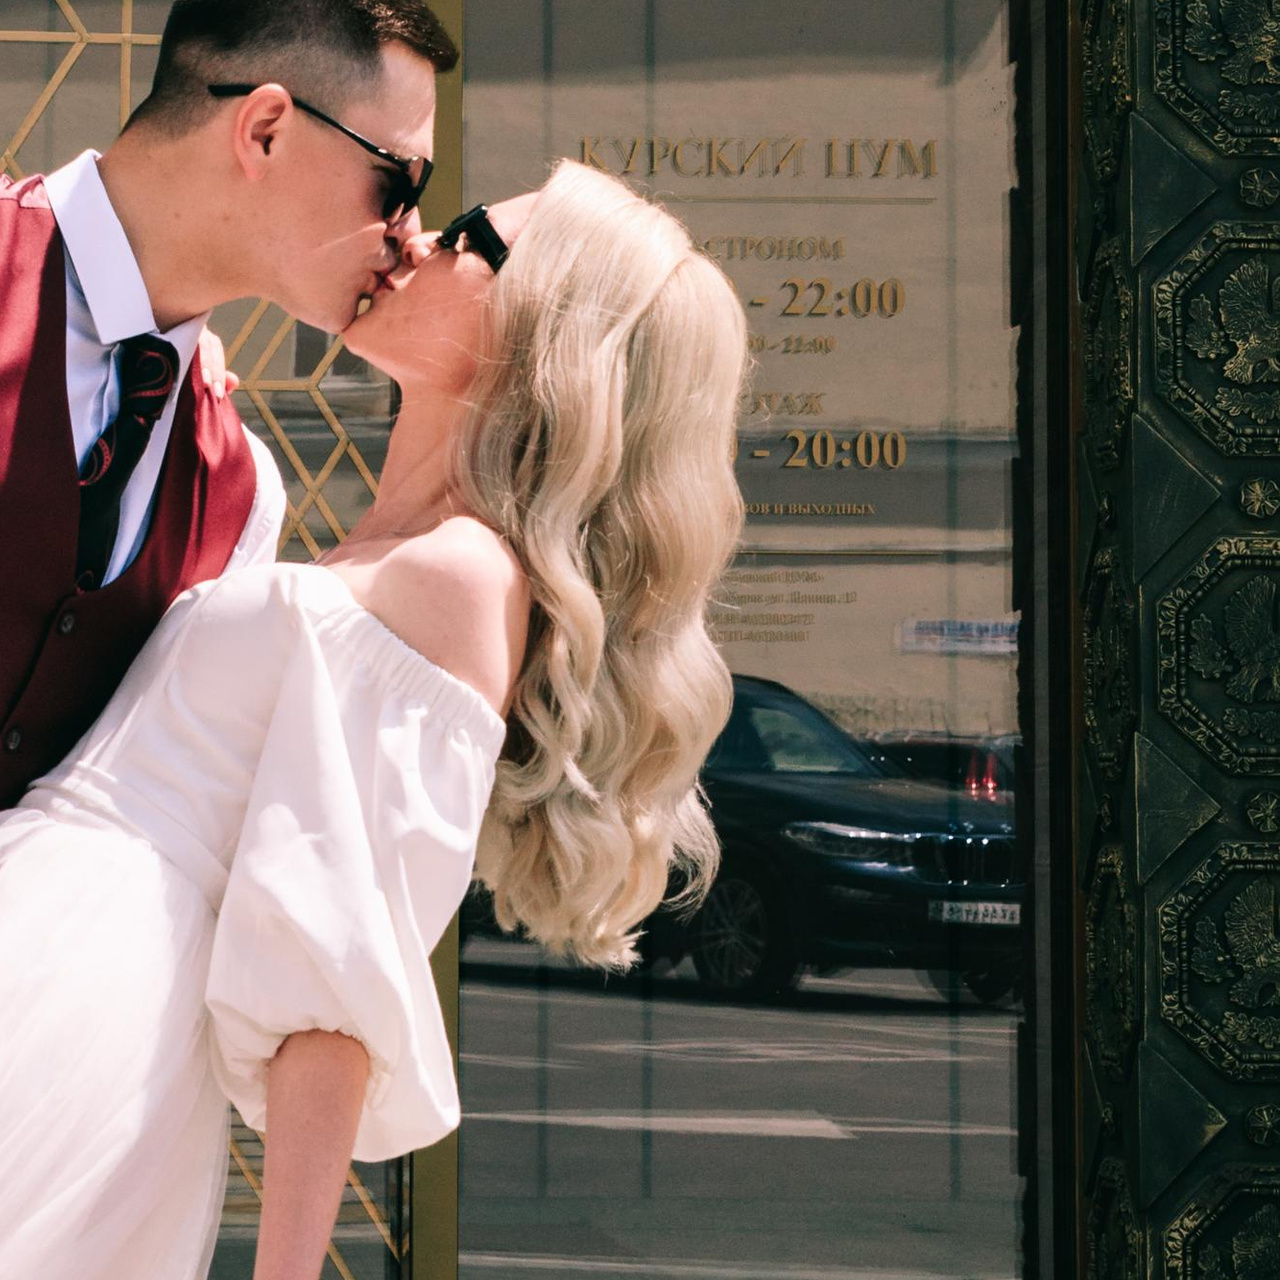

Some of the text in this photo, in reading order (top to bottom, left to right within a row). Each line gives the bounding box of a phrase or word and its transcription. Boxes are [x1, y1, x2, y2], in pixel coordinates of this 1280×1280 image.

[579, 135, 938, 178] КУРСКИЙ ЦУМ
[703, 235, 846, 261] СТРОНОМ
[778, 277, 906, 318] 22:00
[783, 429, 907, 469] 20:00
[789, 502, 876, 517] ВЫХОДНЫХ
